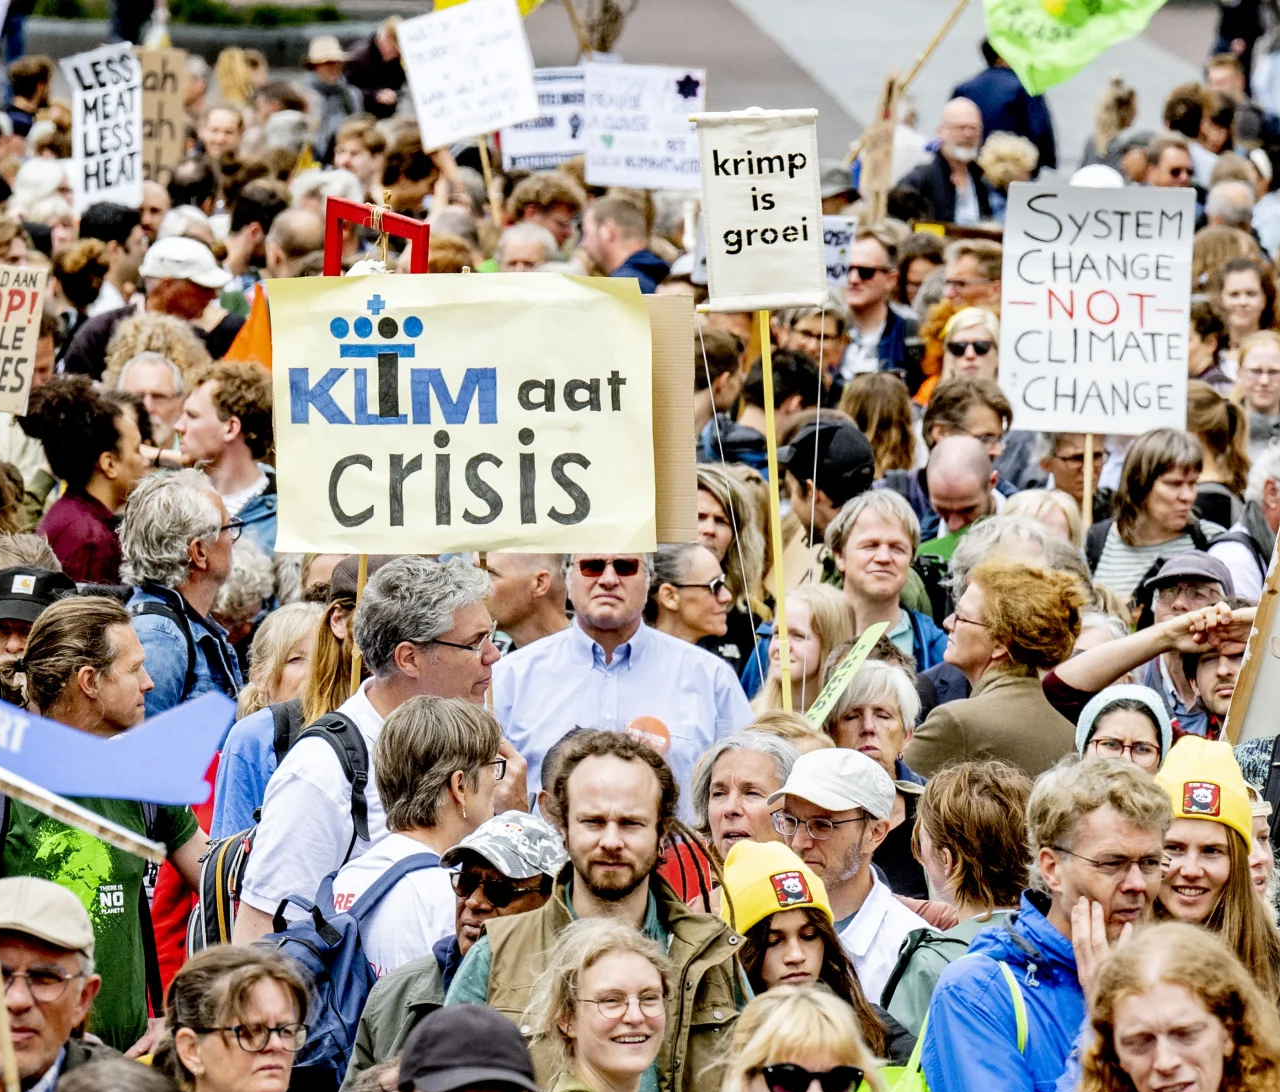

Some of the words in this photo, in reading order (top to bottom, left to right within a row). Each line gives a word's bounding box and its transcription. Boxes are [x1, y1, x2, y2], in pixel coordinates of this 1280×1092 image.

[74, 54, 134, 91] LESS
[83, 86, 141, 124] MEAT
[83, 121, 134, 158] LESS
[84, 152, 141, 192] HEAT
[712, 149, 807, 179] krimp
[751, 187, 775, 211] is
[723, 216, 809, 255] groei
[1023, 193, 1184, 246] SYSTEM
[12, 270, 38, 289] AAN
[1016, 249, 1175, 286] CHANGE
[1014, 327, 1184, 365] CLIMATE
[517, 370, 628, 413] aat
[1022, 376, 1174, 416] CHANGE
[328, 427, 593, 529] crisis
[100, 891, 124, 907] NO
